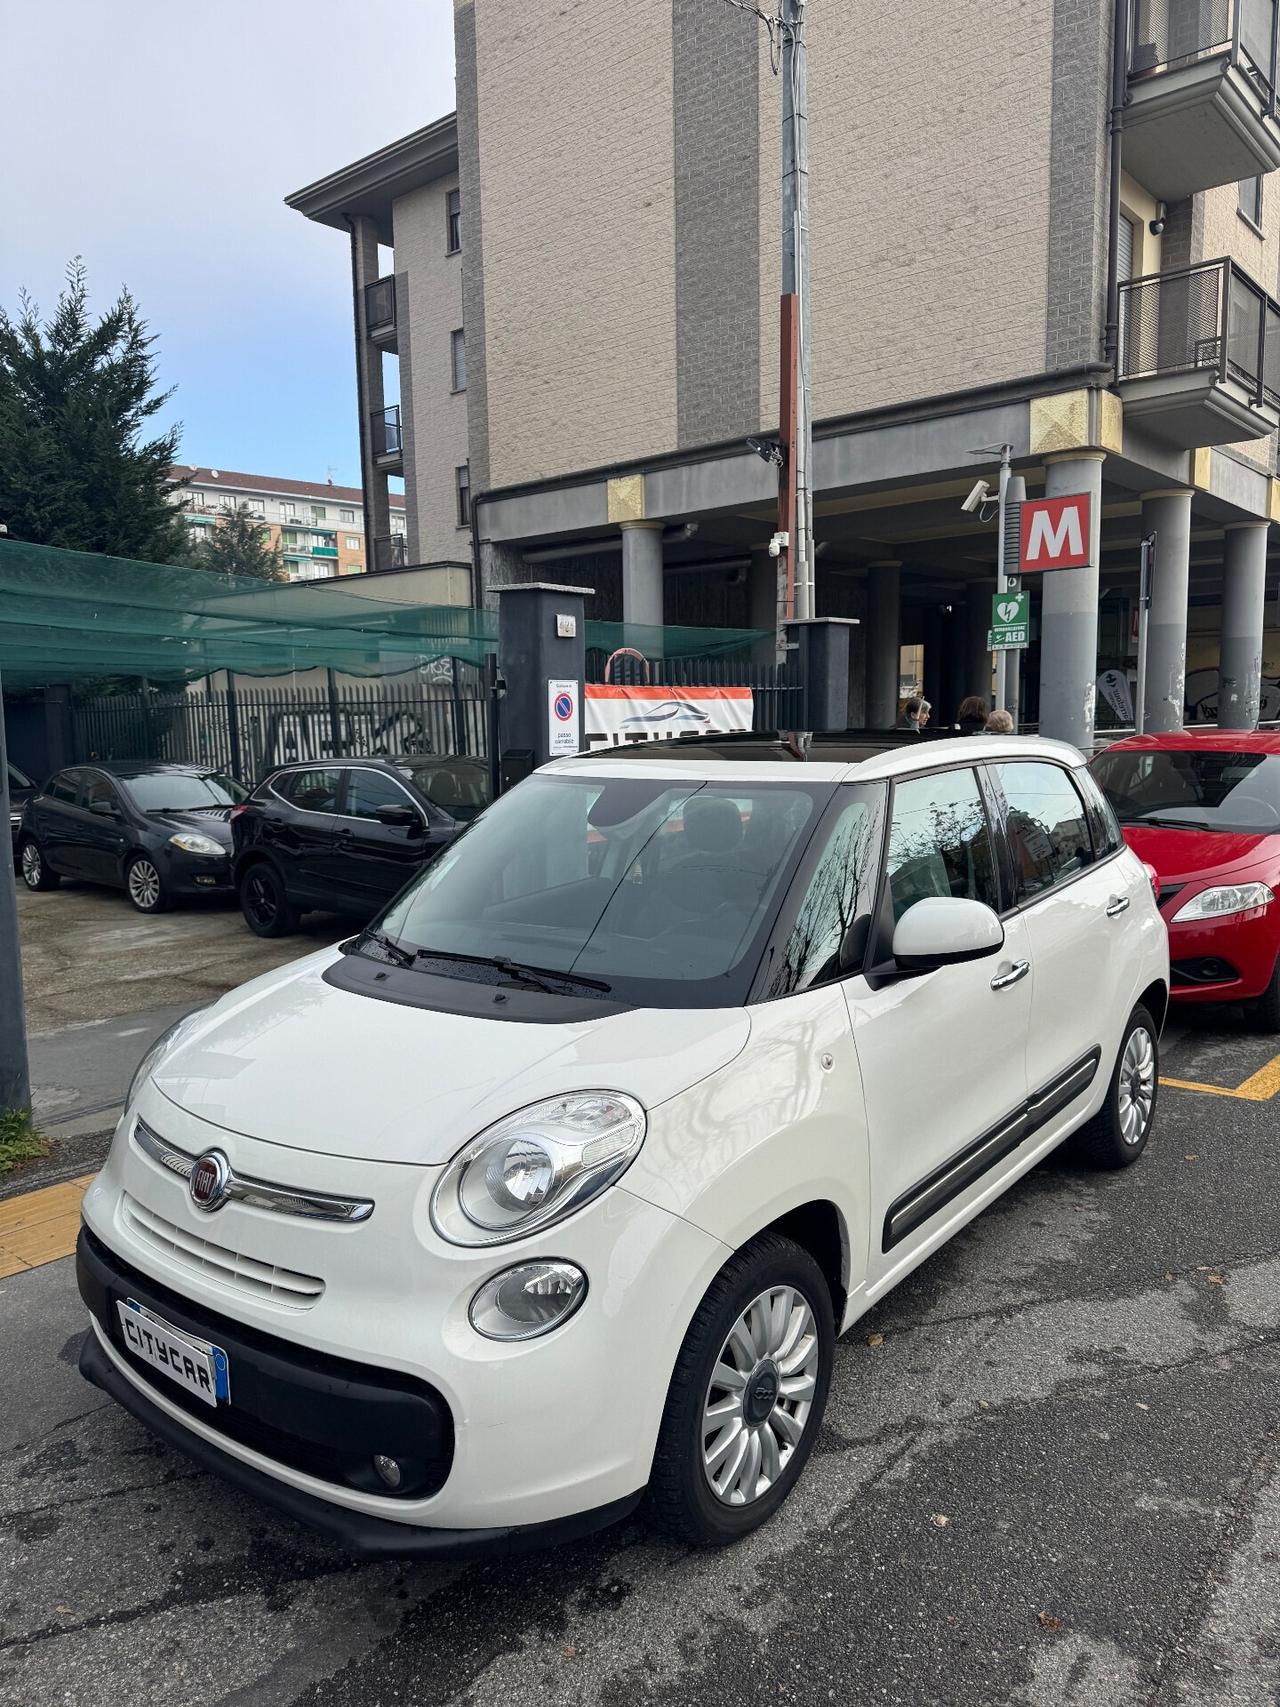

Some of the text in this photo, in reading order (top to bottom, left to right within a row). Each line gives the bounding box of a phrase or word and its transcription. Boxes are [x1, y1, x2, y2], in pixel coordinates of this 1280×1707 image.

[1026, 506, 1083, 560] M
[1005, 631, 1025, 642] AED
[196, 1169, 215, 1193] FIAT
[124, 1318, 212, 1394] CITYCAR
